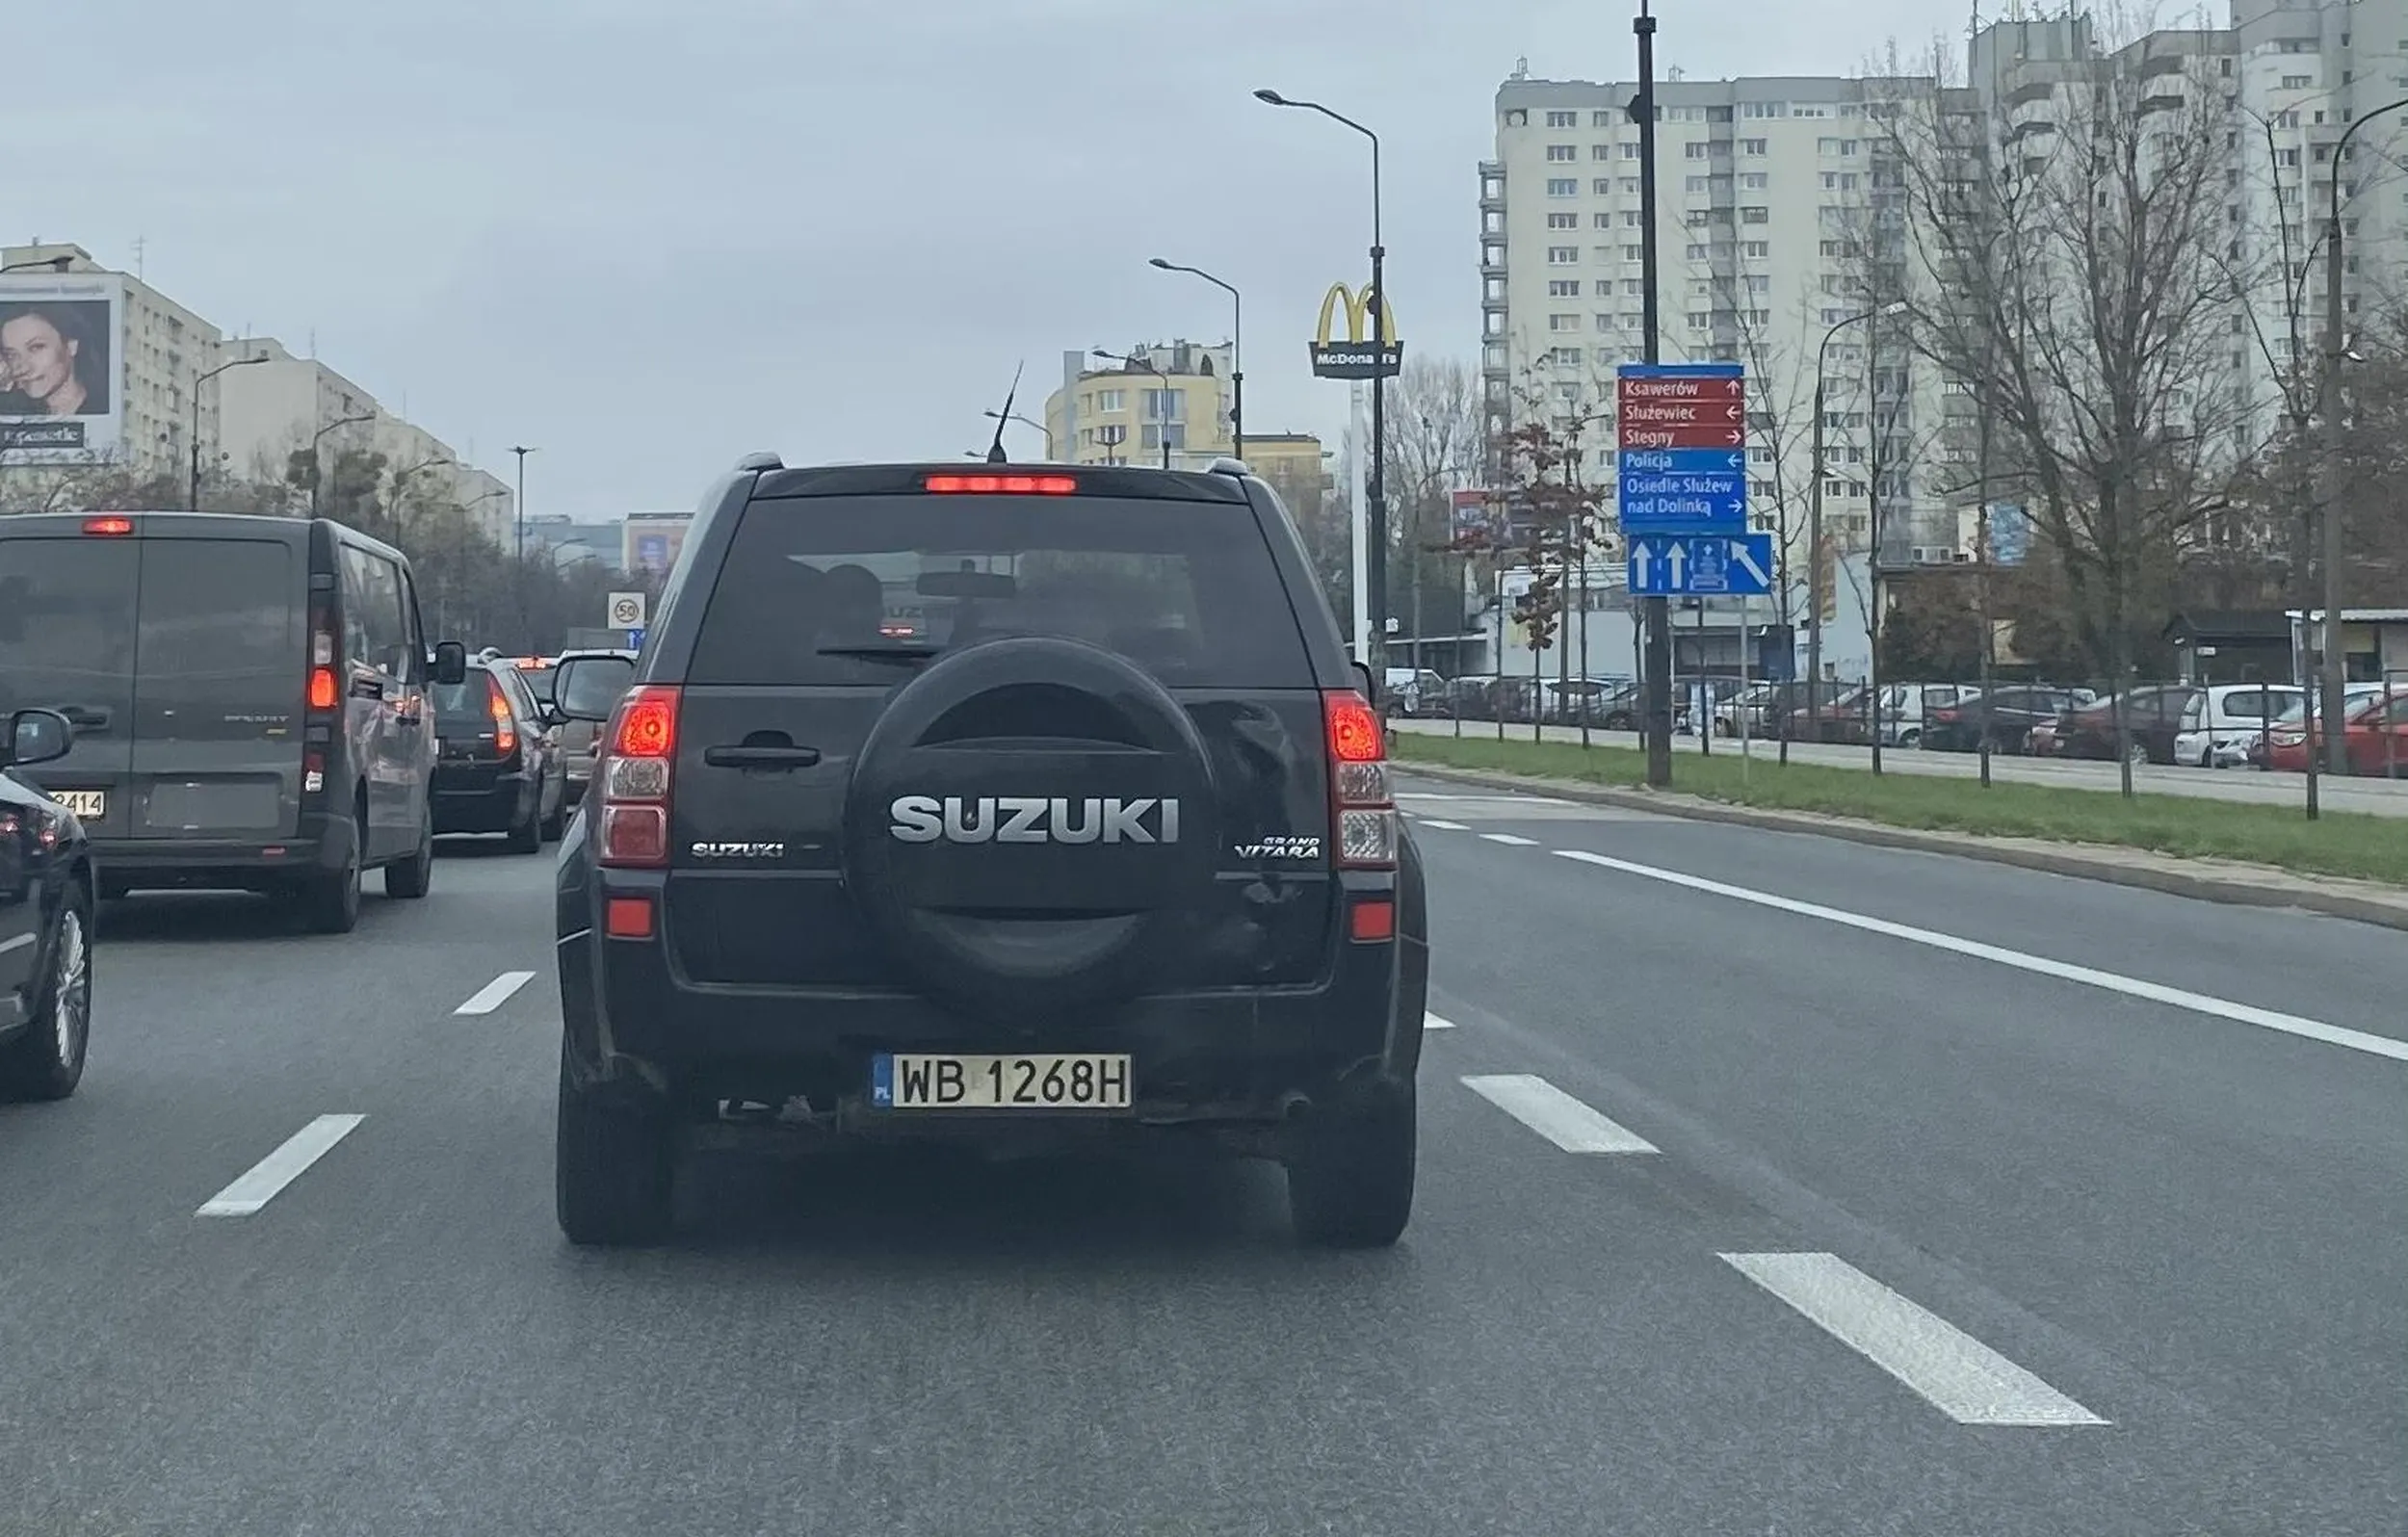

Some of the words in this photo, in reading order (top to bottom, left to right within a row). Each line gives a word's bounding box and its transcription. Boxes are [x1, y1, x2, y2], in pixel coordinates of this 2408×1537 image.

[1317, 353, 1398, 364] McDona's
[1625, 380, 1699, 396] Ksawerów
[1625, 404, 1696, 421] Służewiec
[1625, 430, 1674, 448] Stegny
[1626, 454, 1673, 471] Policja
[1627, 478, 1681, 493] Osiedle
[1683, 478, 1733, 493] Służew
[1627, 499, 1655, 513] nad
[1658, 498, 1712, 516] Dolinką
[619, 605, 636, 617] 50
[890, 795, 1179, 843] SUZUKI
[1263, 837, 1321, 846] GRAND
[692, 843, 784, 857] SUZUKI
[1234, 846, 1319, 858] VITARA
[902, 1058, 965, 1103] WB
[987, 1058, 1126, 1103] 1268H
[874, 1086, 892, 1100] PL
